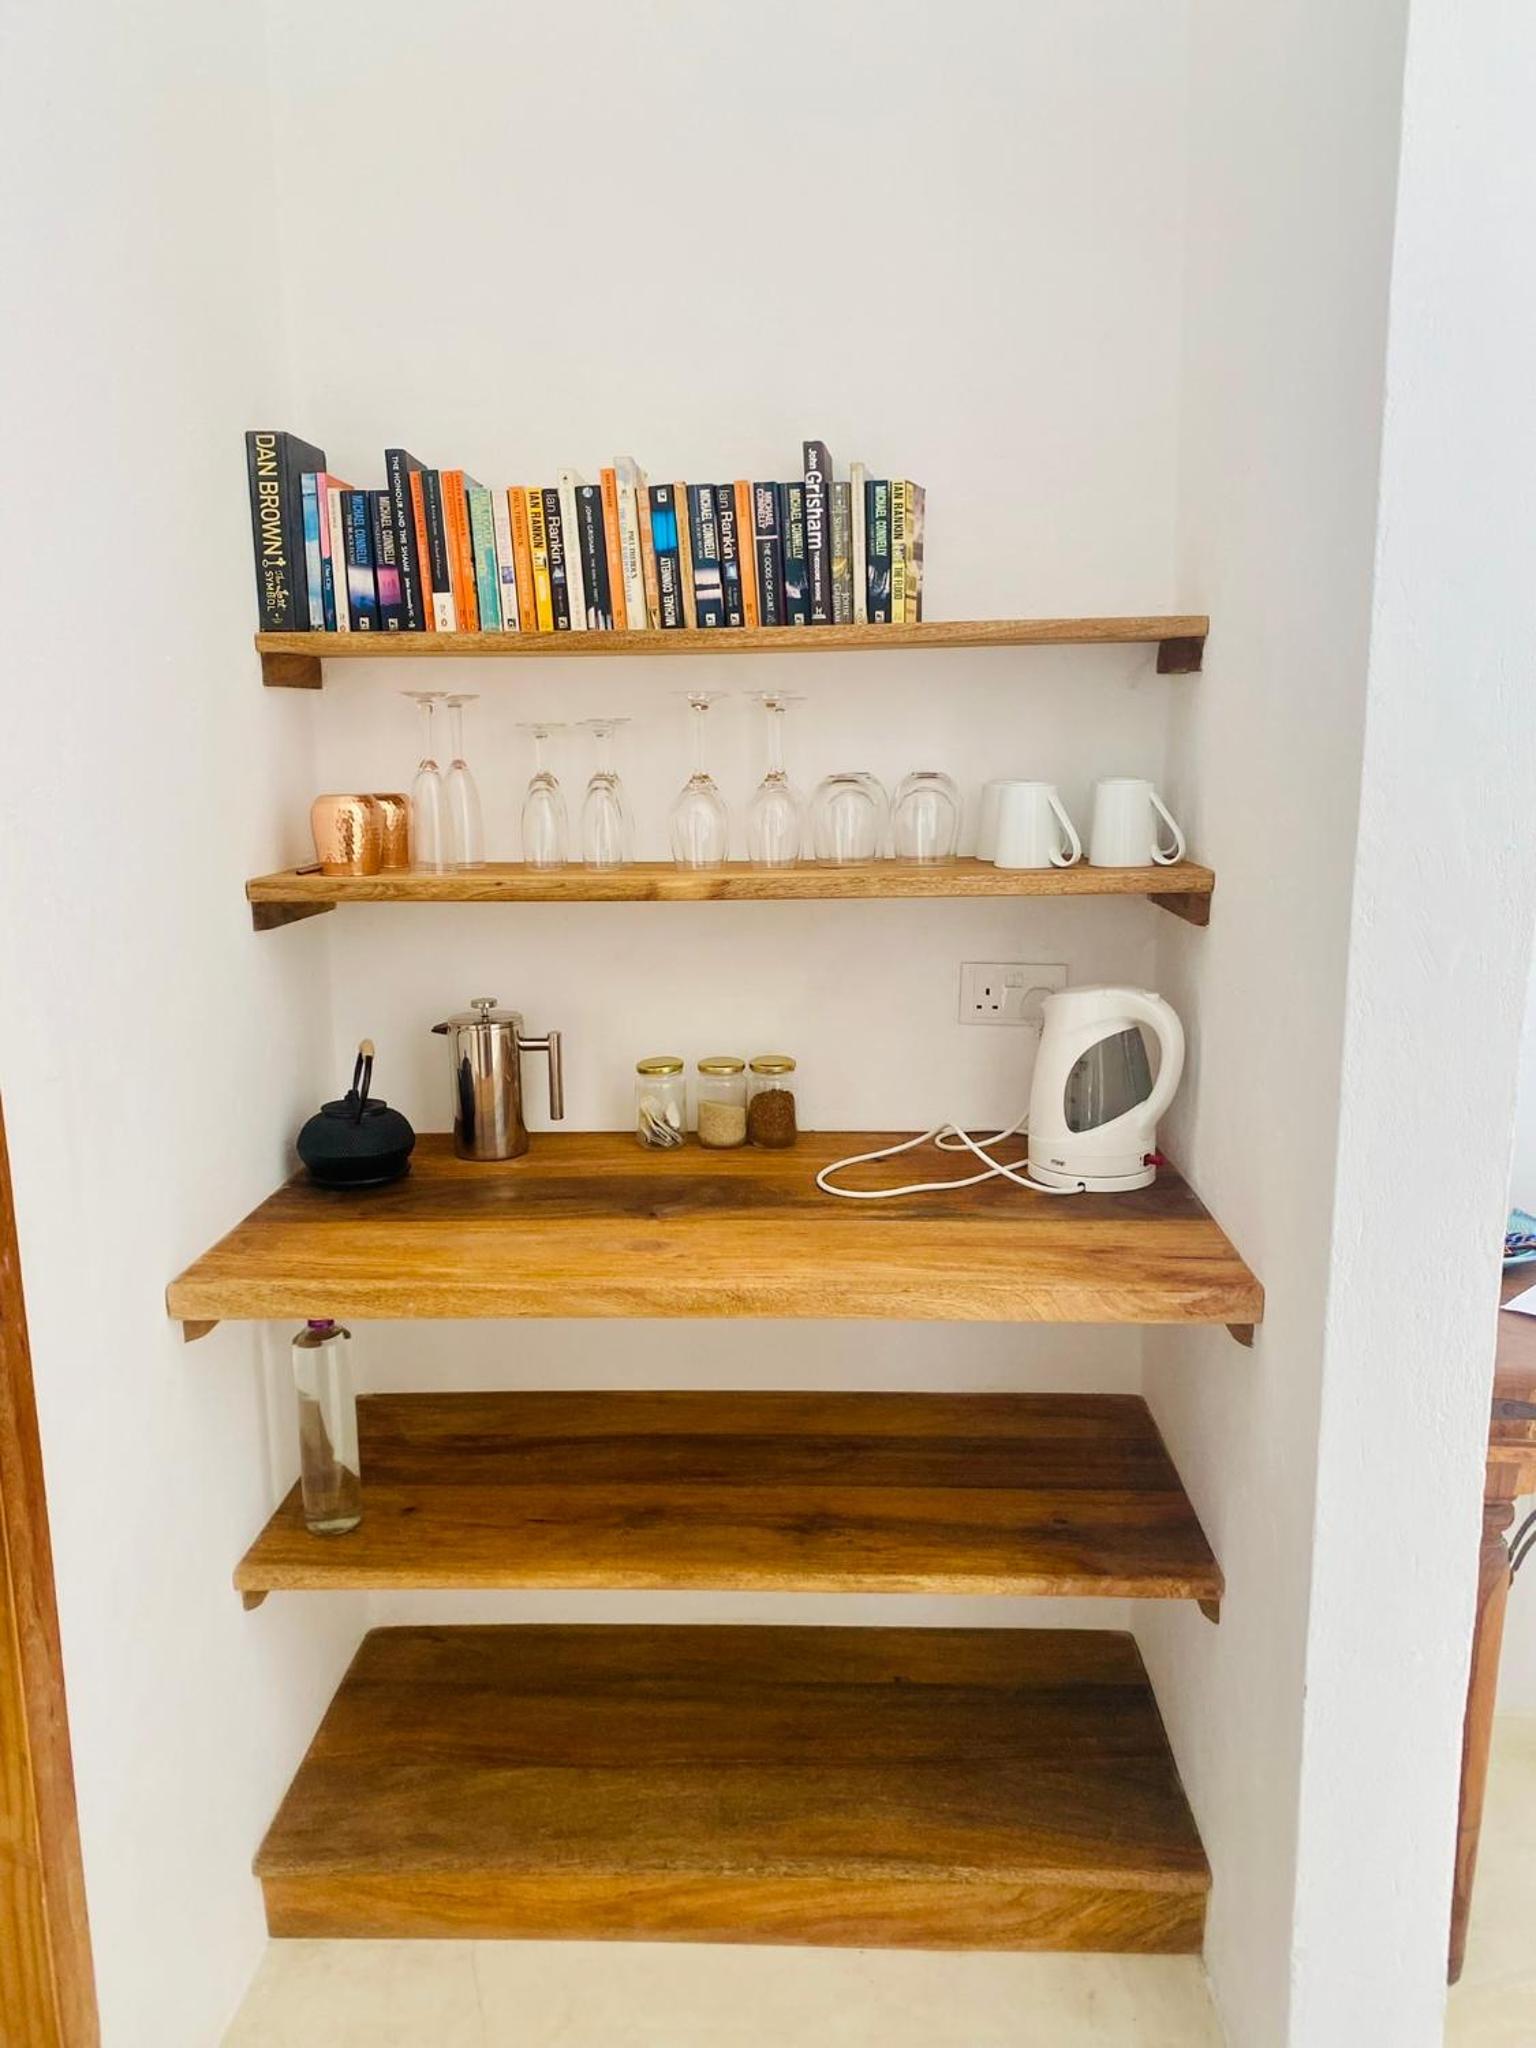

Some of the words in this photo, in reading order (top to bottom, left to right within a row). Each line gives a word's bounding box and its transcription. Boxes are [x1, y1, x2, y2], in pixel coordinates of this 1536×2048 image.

[255, 433, 276, 477] DAN
[391, 456, 399, 471] THE
[808, 448, 817, 470] John
[392, 473, 403, 509] HONOUR
[528, 491, 541, 509] IAN
[546, 494, 557, 513] Ian
[699, 488, 711, 521] MICHAEL
[718, 489, 729, 509] Ian
[789, 488, 801, 521] MICHAEL
[874, 485, 886, 519] MICHAEL
[893, 482, 904, 500] IAN
[259, 481, 283, 556] BROWN
[352, 495, 365, 527] MICHAEL
[379, 496, 392, 528] MICHAEL
[397, 510, 406, 528] AND
[584, 504, 593, 524] JOHN
[756, 488, 766, 529] CONNELLY
[764, 491, 774, 526] MICHAEL
[806, 471, 824, 550] Grisham
[893, 502, 905, 540] RANKIN
[398, 529, 407, 544] THE
[529, 511, 544, 549] RANKIN
[548, 516, 563, 565] Rankin
[702, 523, 716, 560] CONNELLY
[720, 511, 735, 560] Rankin
[791, 523, 804, 560] CONNELLY
[875, 520, 888, 557] CONNELLY
[354, 529, 368, 565] CONNELLY
[382, 529, 395, 565] CONNELLY
[400, 546, 410, 573] SHAME
[763, 542, 771, 556] THE
[660, 556, 674, 594] CONNELLY
[764, 557, 773, 579] GODS
[894, 567, 903, 579] THE
[266, 570, 277, 612] SYMBOL
[765, 579, 773, 591] OF
[766, 591, 775, 611] GUILT
[664, 596, 676, 626] MICHAEL
